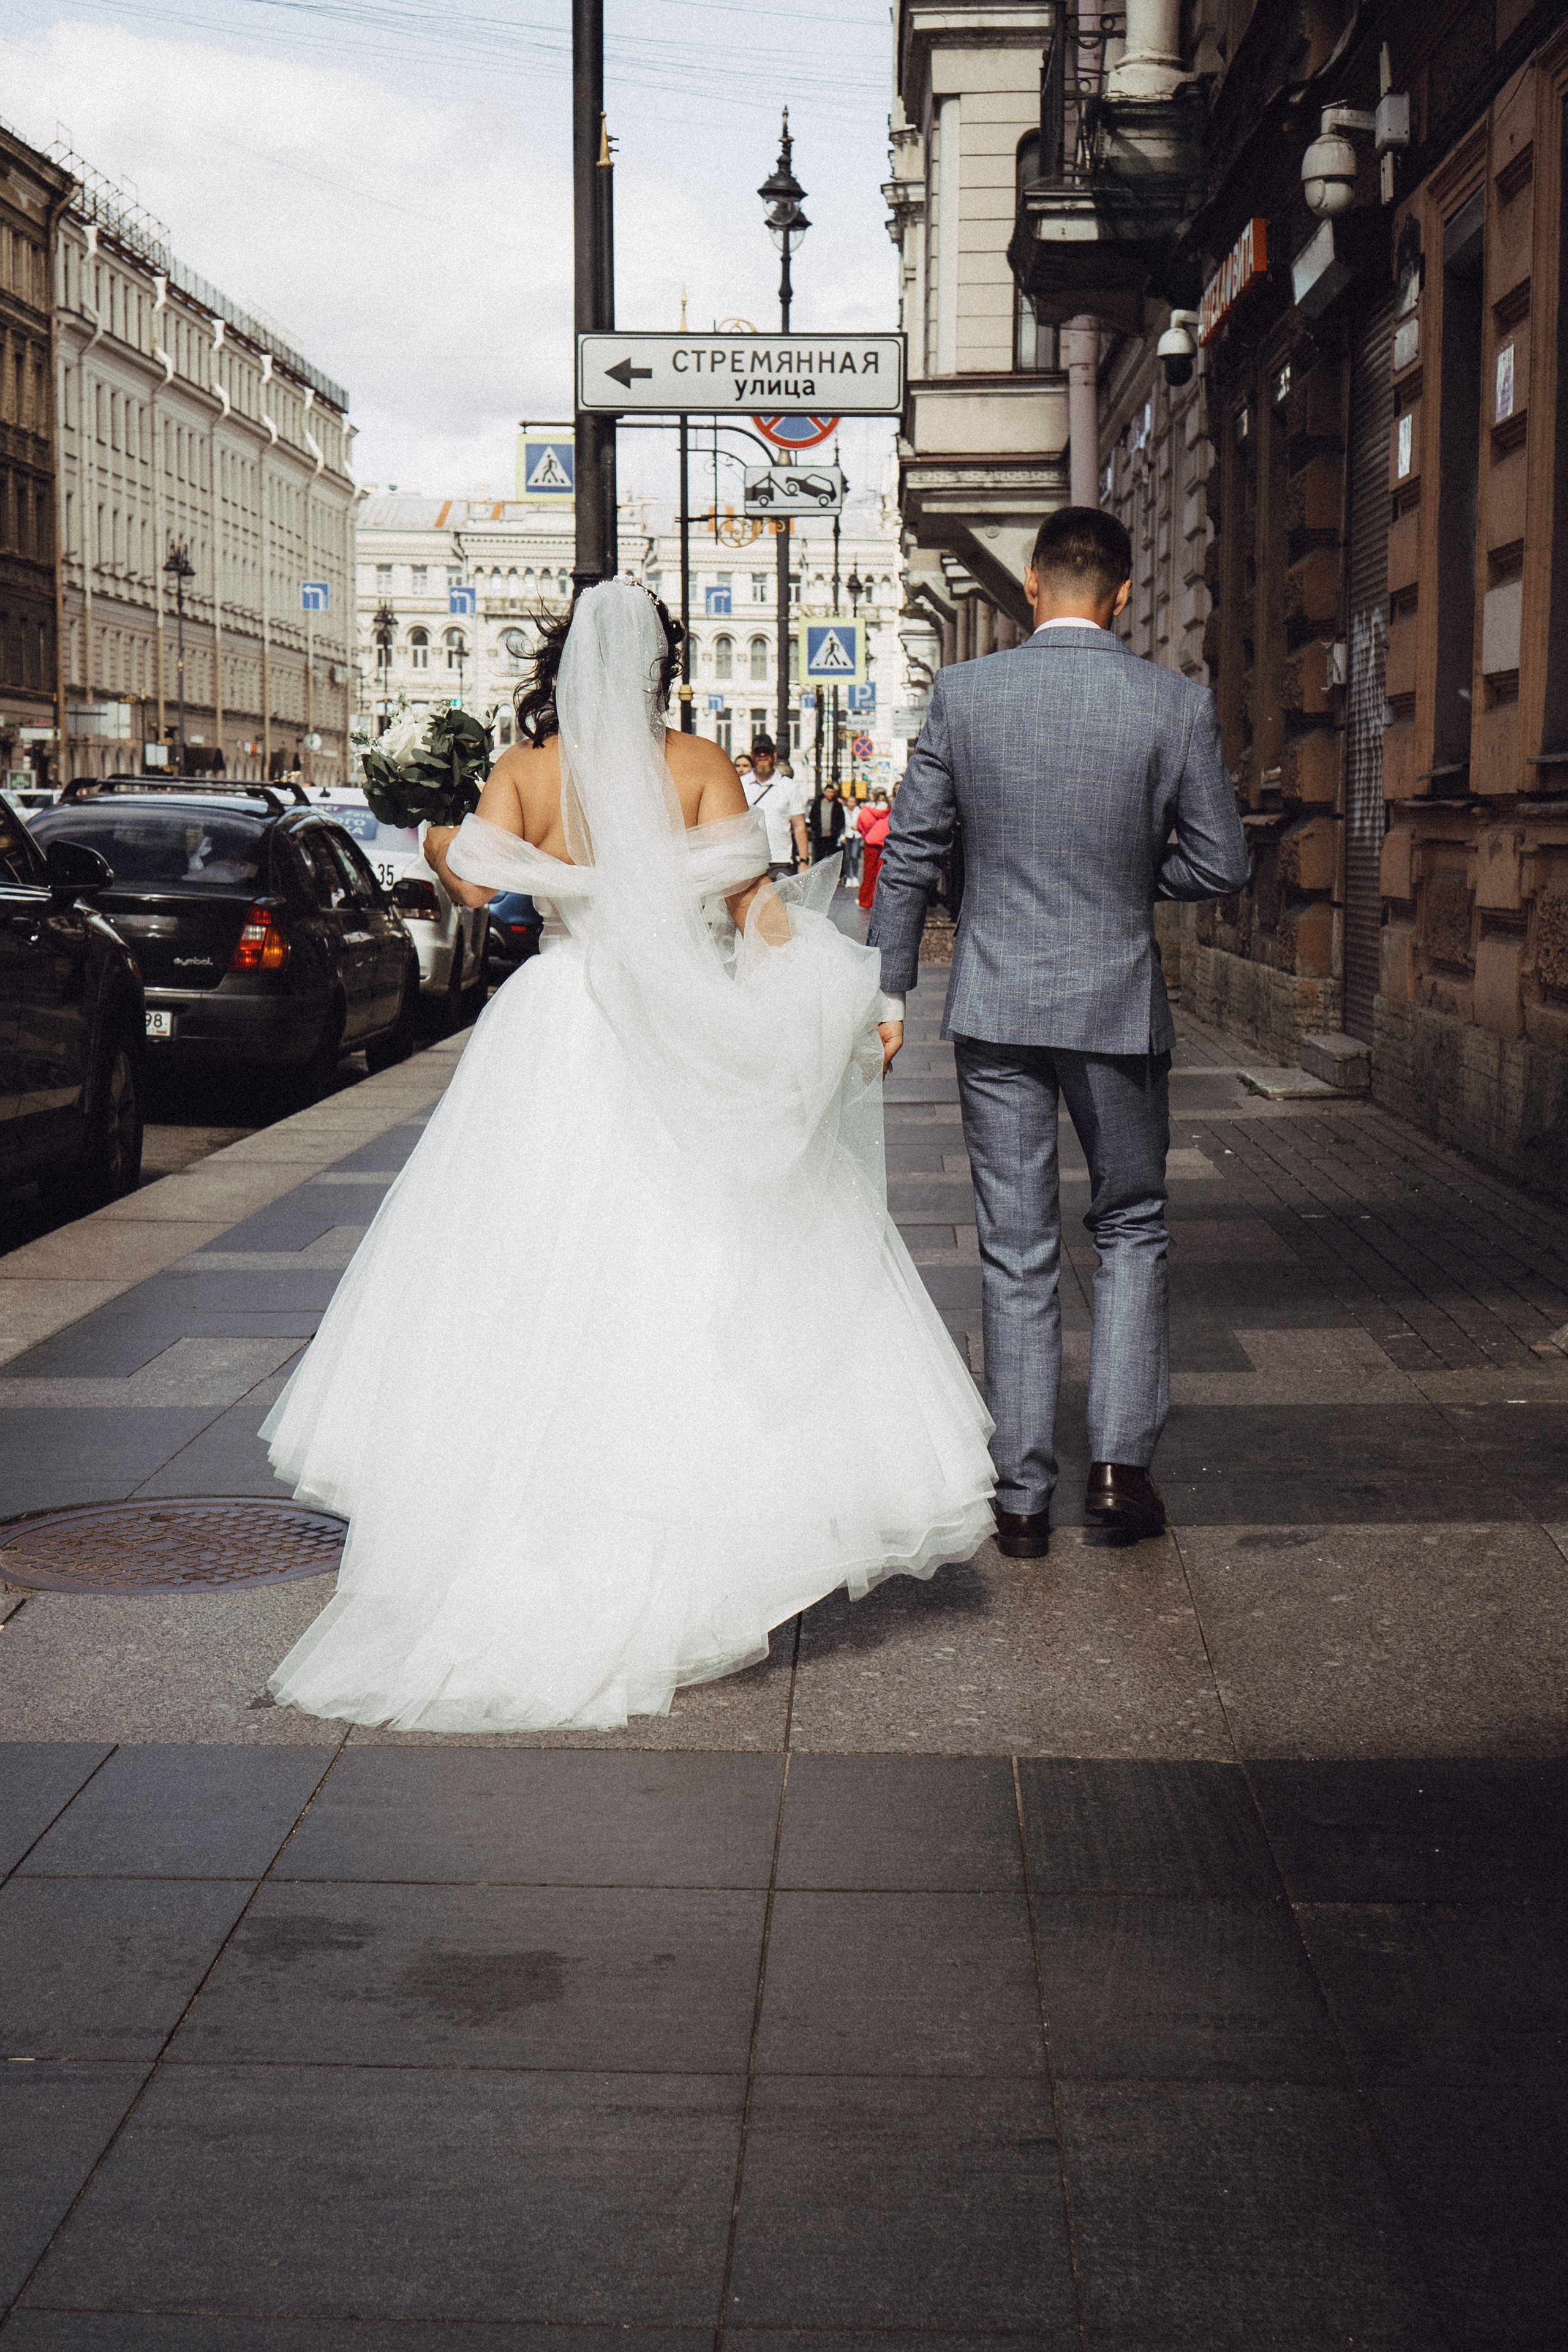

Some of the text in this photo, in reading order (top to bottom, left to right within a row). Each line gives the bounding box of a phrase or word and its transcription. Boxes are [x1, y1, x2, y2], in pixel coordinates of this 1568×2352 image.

[673, 350, 879, 374] СТРЕМЯННАЯ
[734, 379, 816, 401] улица
[369, 864, 394, 886] 35
